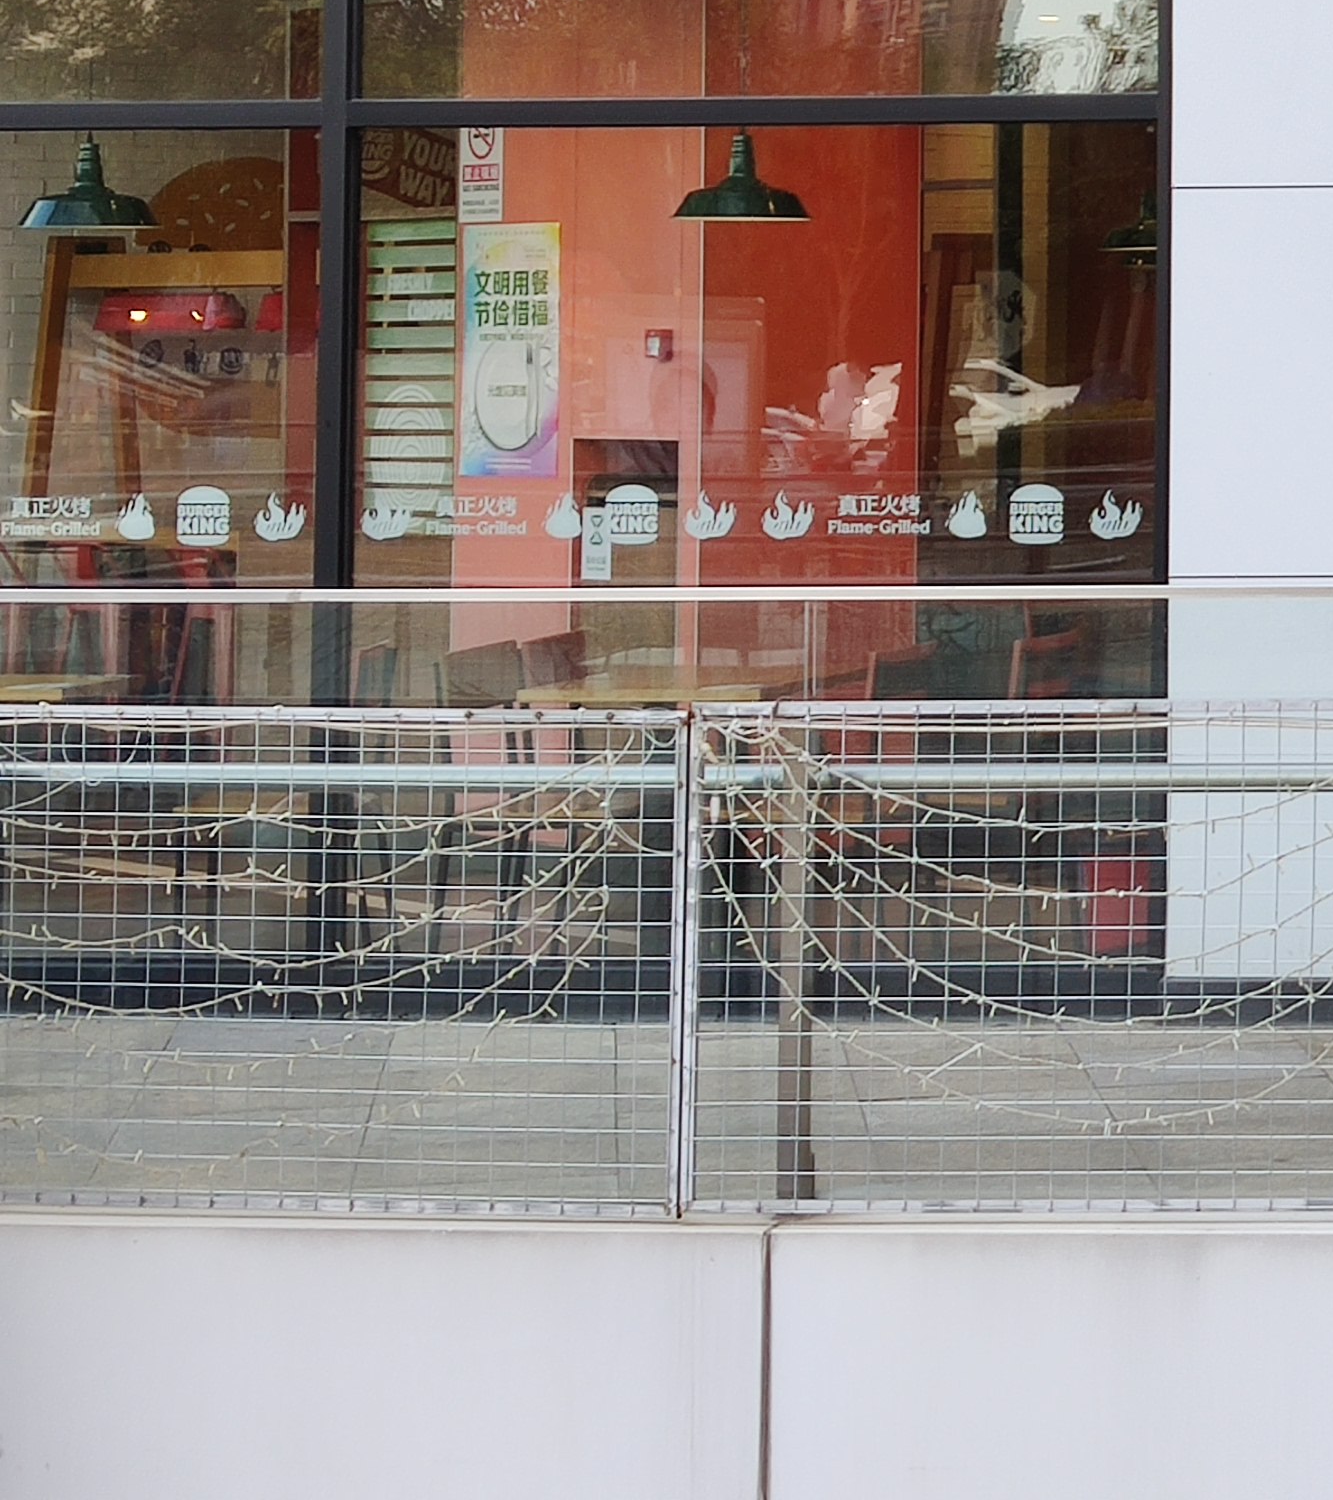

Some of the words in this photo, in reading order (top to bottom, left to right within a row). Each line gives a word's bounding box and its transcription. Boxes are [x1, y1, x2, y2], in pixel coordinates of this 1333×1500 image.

[362, 142, 394, 161] ING
[400, 165, 450, 206] WAY
[473, 269, 549, 297] 文明用餐
[473, 300, 549, 328] 节俭惜福
[11, 496, 92, 519] 真正火烤
[177, 503, 230, 518] BURGER
[436, 496, 518, 518] 真正火烤
[838, 494, 922, 517] 真正火烤
[1010, 502, 1064, 516] BURGER
[1, 520, 101, 537] Flame-Grilled
[177, 516, 230, 535] KING
[425, 519, 527, 536] Flame-Grilled
[608, 514, 659, 534] KING
[827, 519, 931, 536] Flame-Grilled
[1010, 515, 1064, 534] KING
